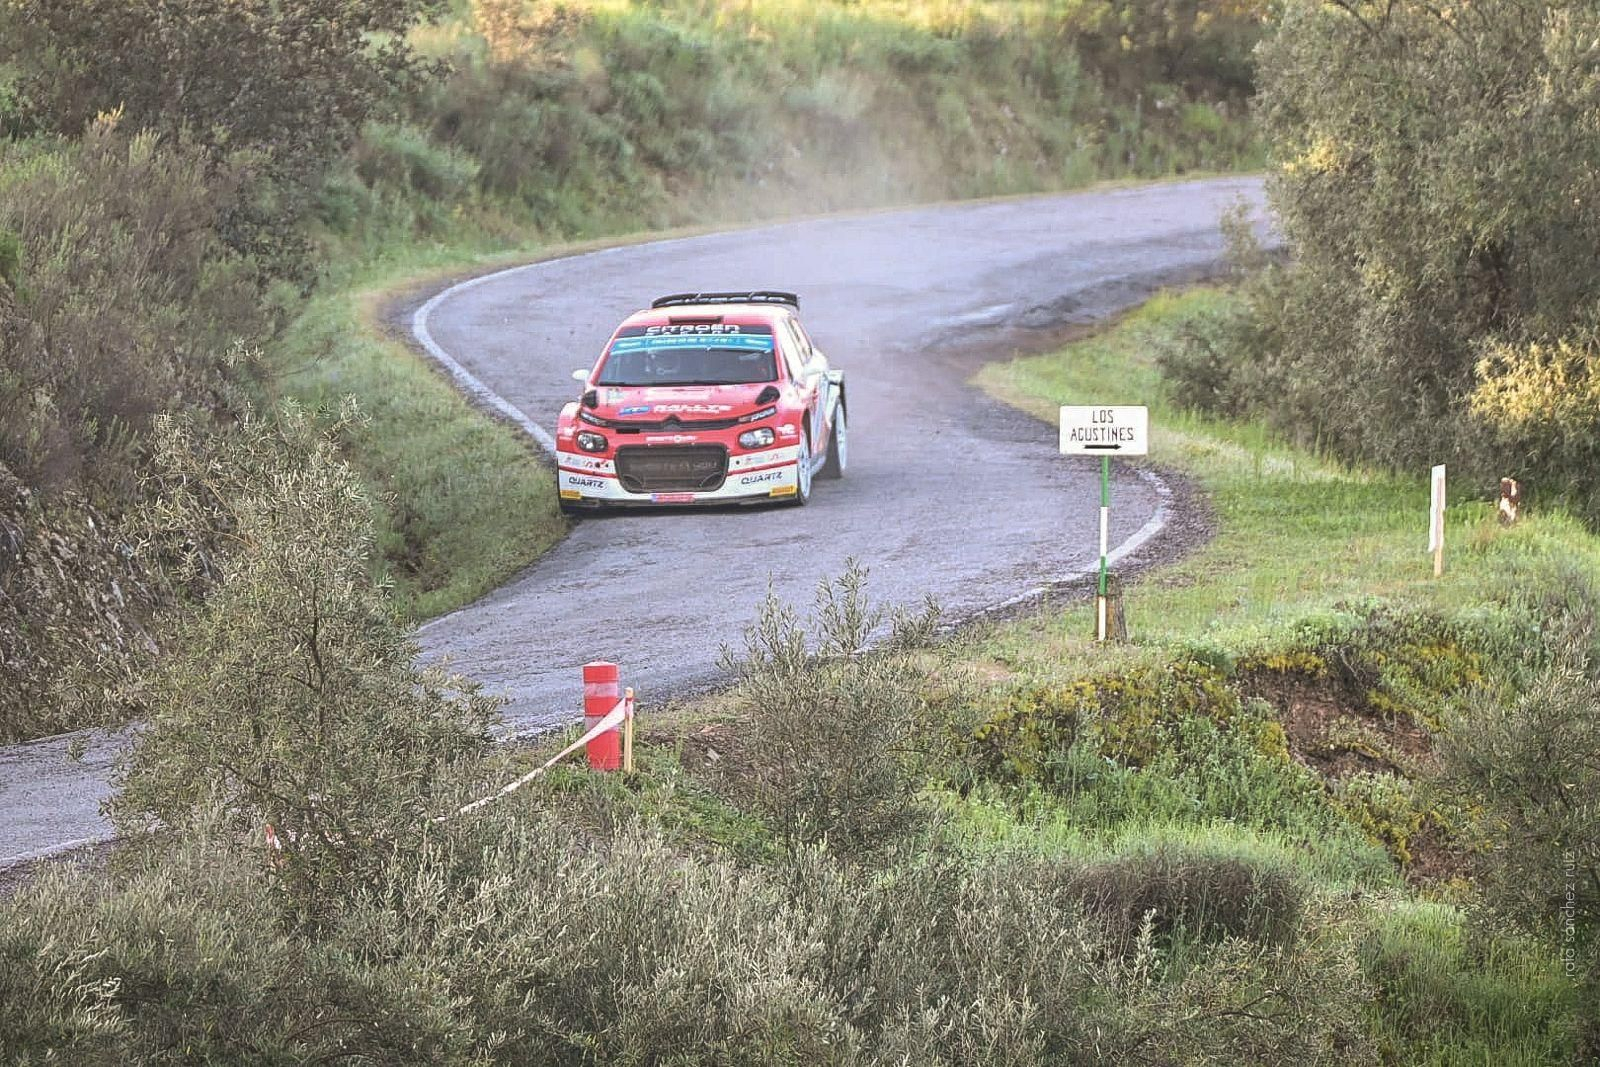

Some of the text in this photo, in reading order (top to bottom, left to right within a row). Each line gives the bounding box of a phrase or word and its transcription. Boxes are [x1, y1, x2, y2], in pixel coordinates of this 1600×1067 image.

[1092, 409, 1114, 424] LOS
[568, 476, 605, 489] QUARTZ
[740, 471, 783, 485] QUARTZ
